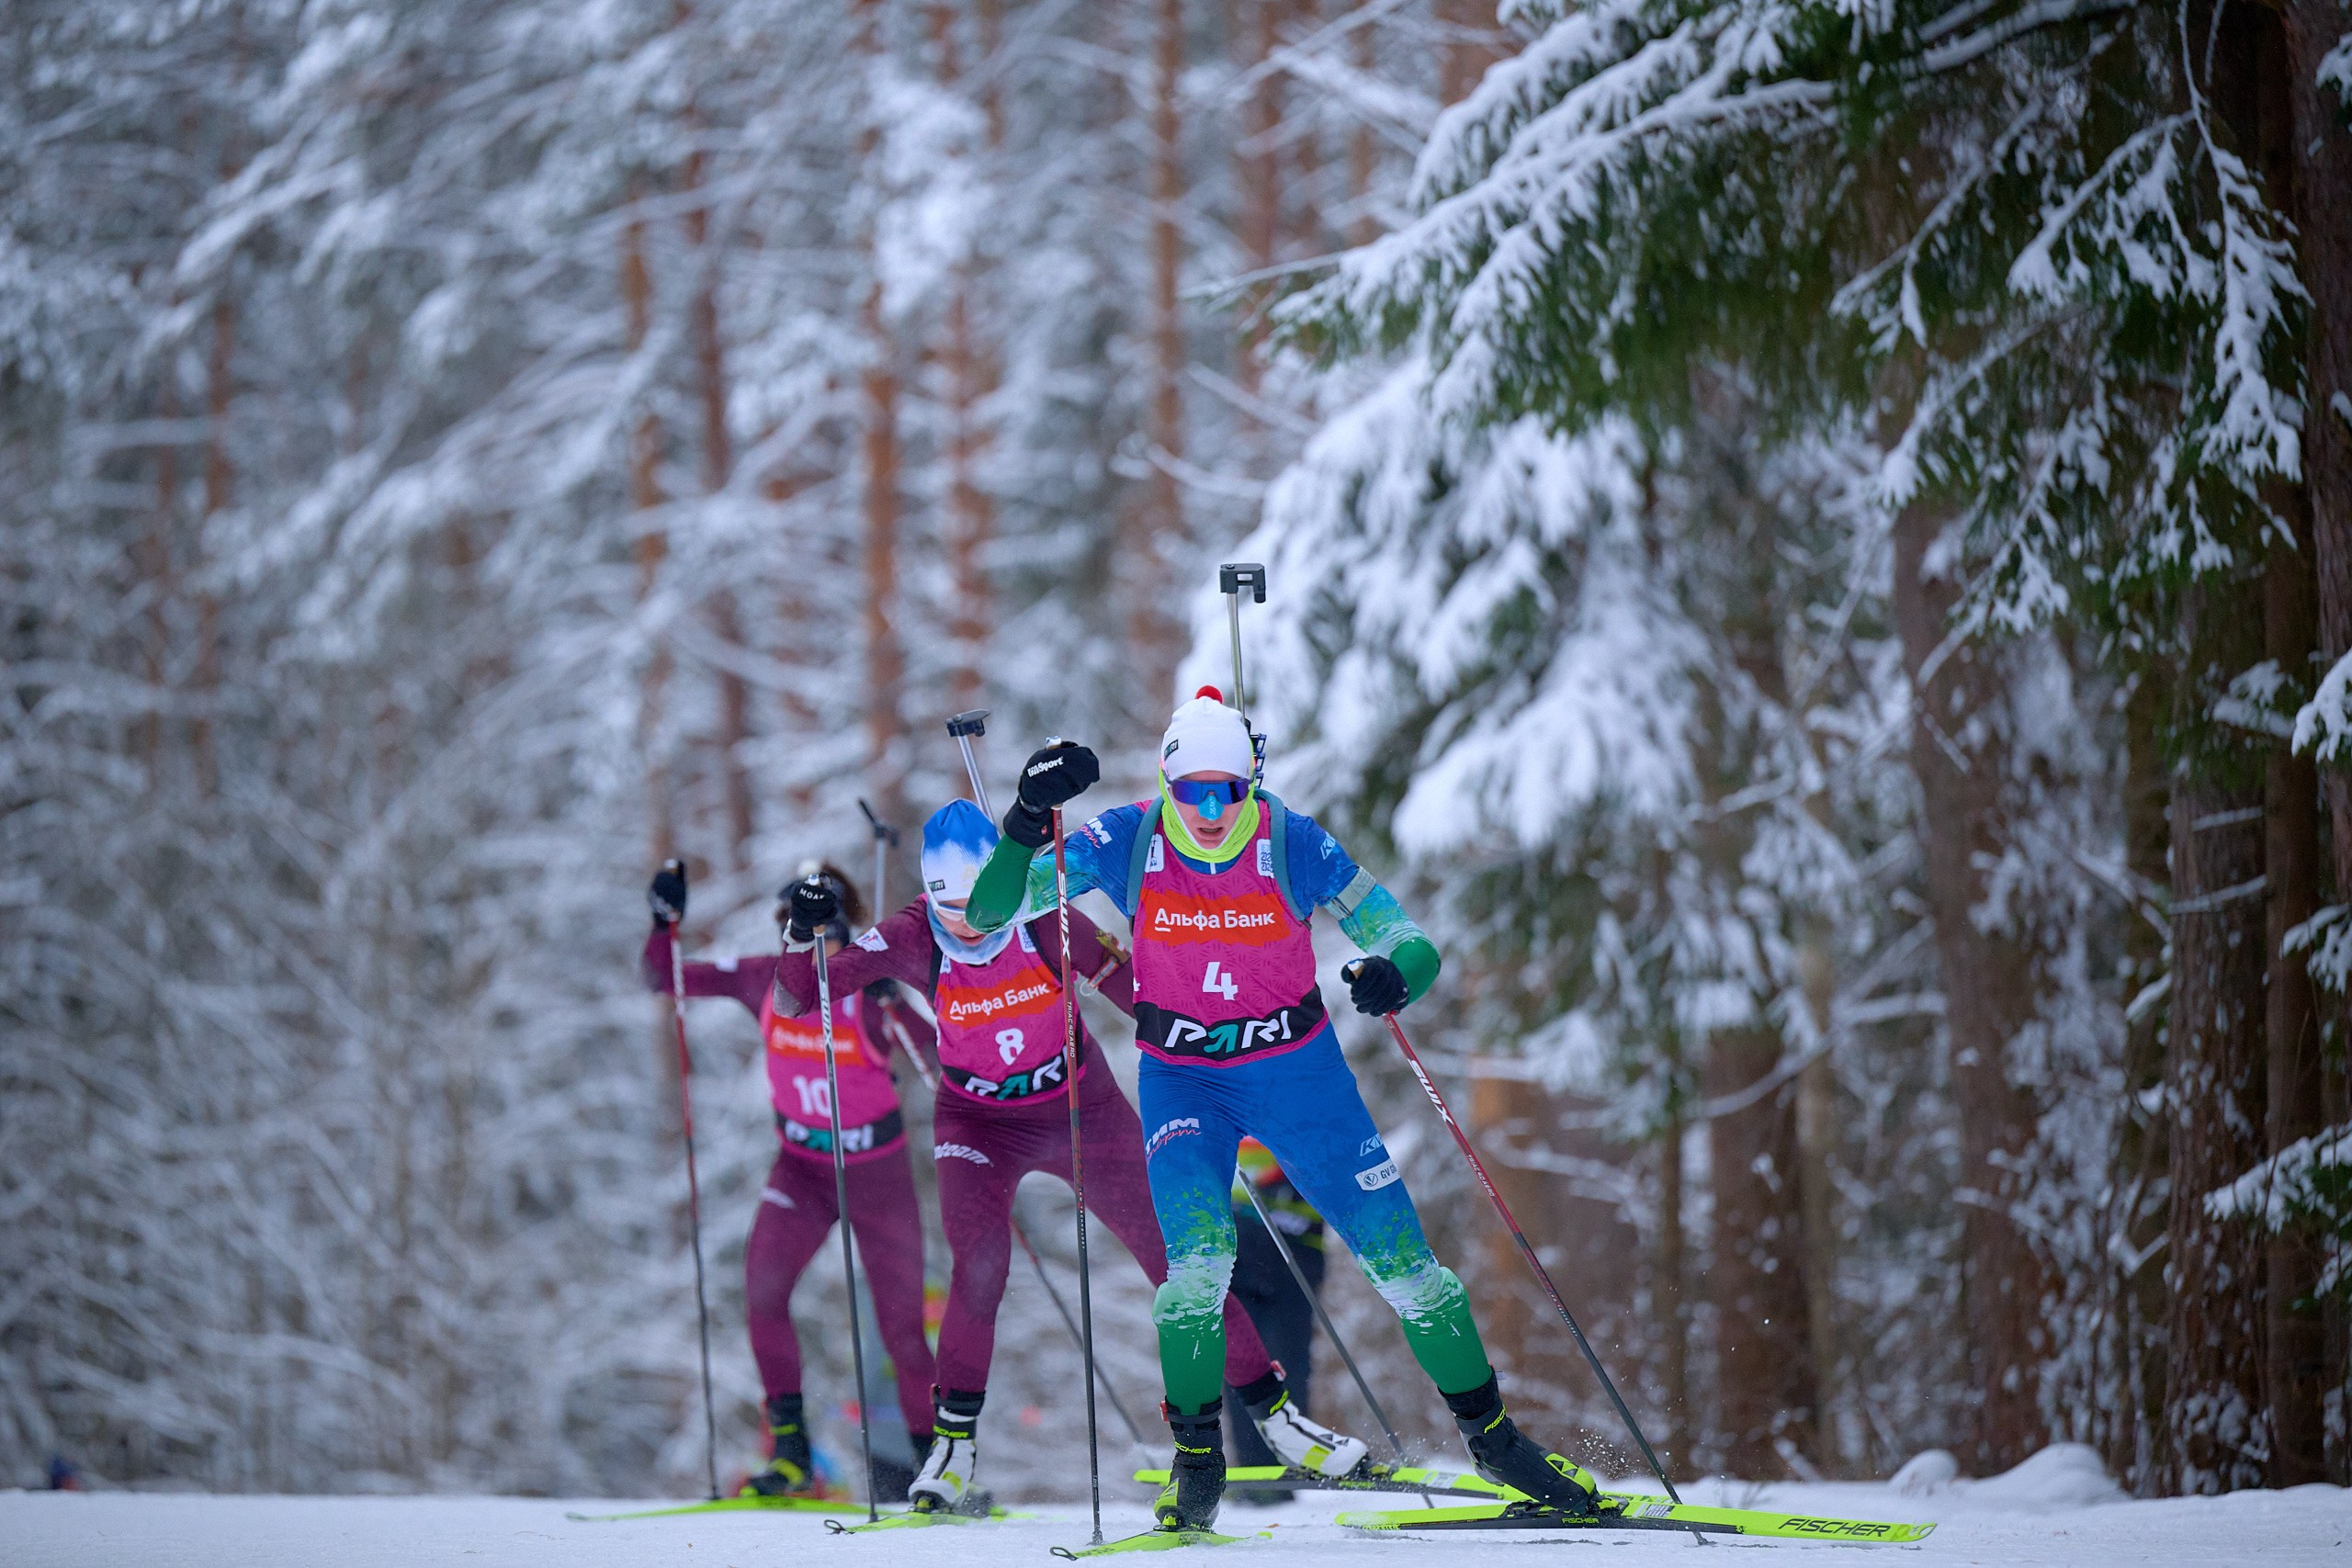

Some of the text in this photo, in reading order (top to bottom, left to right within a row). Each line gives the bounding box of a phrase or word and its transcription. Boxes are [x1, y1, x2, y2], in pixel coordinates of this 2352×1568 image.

[1057, 870, 1071, 962] SWIX
[1155, 908, 1275, 931] Альфа Банк
[1202, 962, 1238, 1000] 4
[949, 982, 1050, 1019] Альфа Банк
[995, 1028, 1025, 1066] 8
[1163, 1010, 1294, 1054] PARI
[1408, 1058, 1454, 1125] SWIX
[1778, 1517, 1891, 1538] FISCHER
